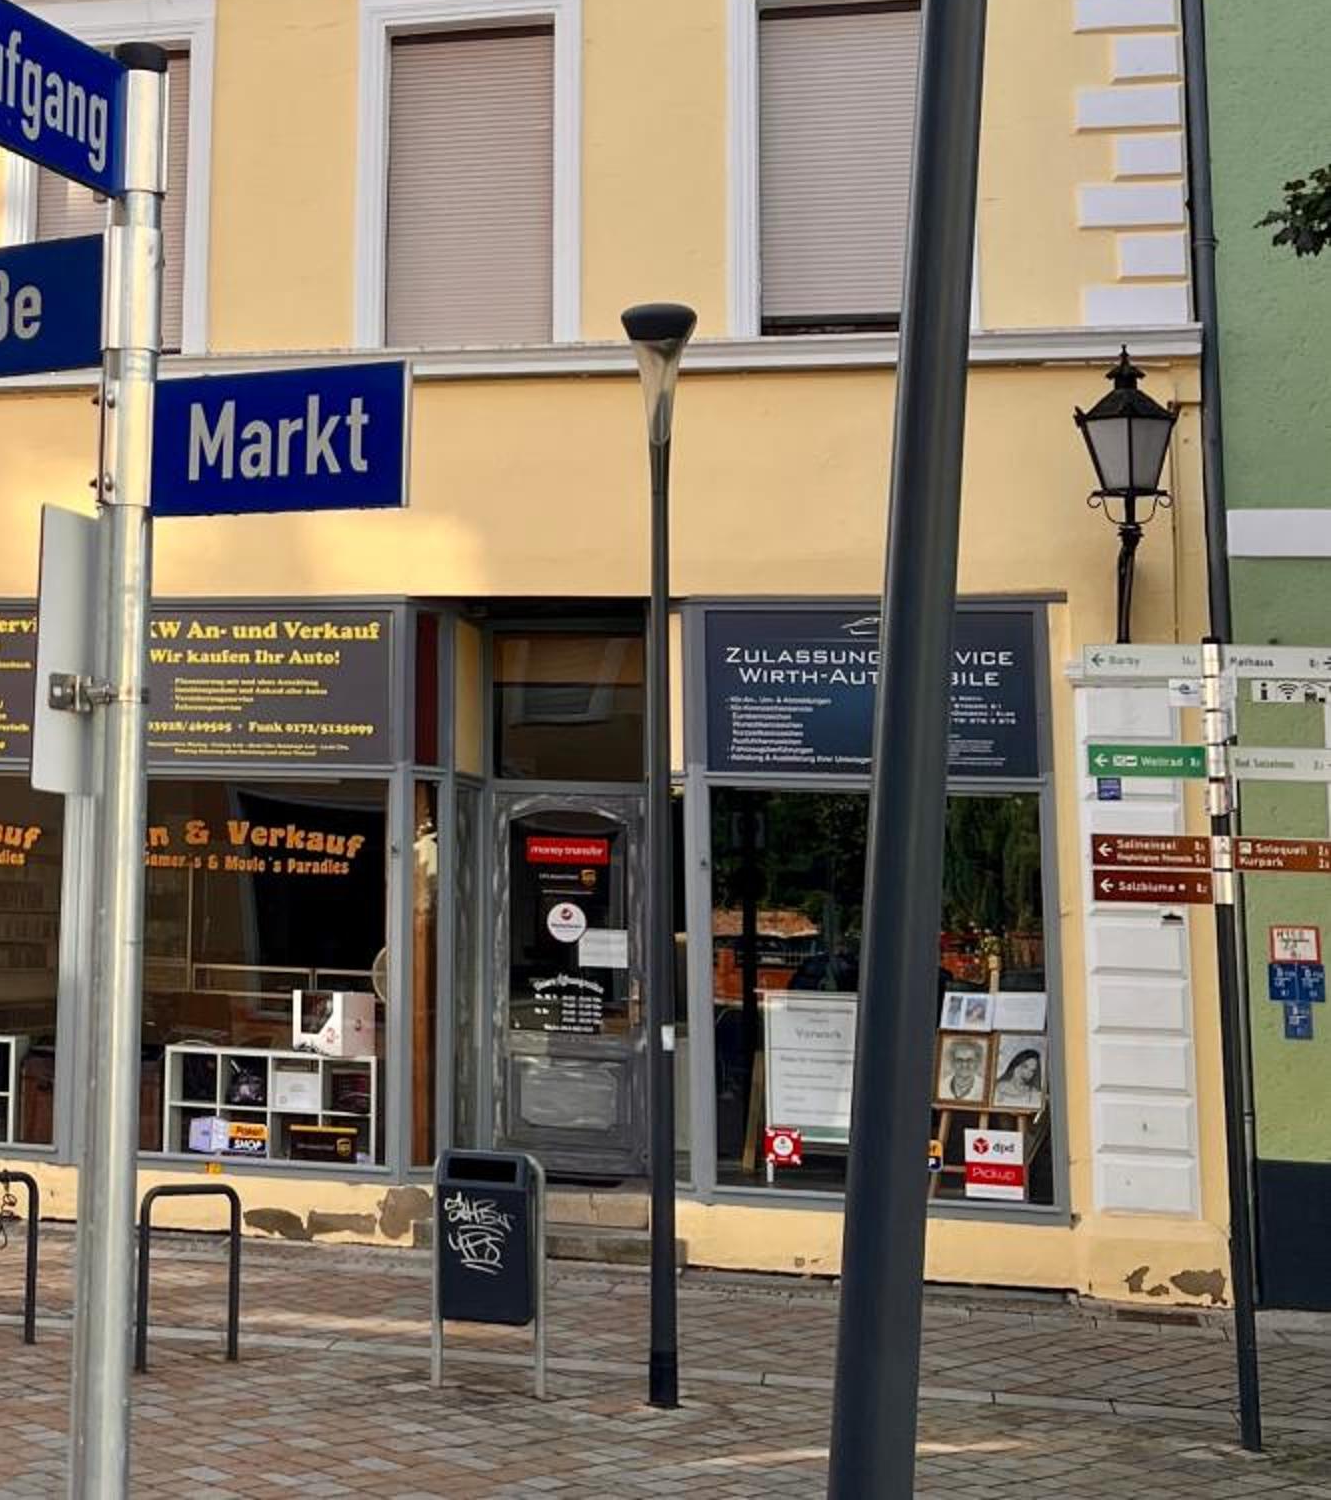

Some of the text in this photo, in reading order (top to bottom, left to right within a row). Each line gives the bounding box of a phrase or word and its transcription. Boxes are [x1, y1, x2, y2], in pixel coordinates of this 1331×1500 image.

[188, 393, 369, 481] Markt
[187, 620, 227, 639] An-
[233, 621, 278, 639] und
[283, 620, 381, 640] Verkauf
[149, 649, 341, 665] Wir kaufen Ihr Auto!
[248, 721, 284, 733] Funk
[185, 819, 211, 845] &
[227, 819, 366, 858] Verkauf
[287, 857, 350, 875] Paradies
[1239, 857, 1284, 868] Kurpark
[234, 1139, 263, 1150] SHOP
